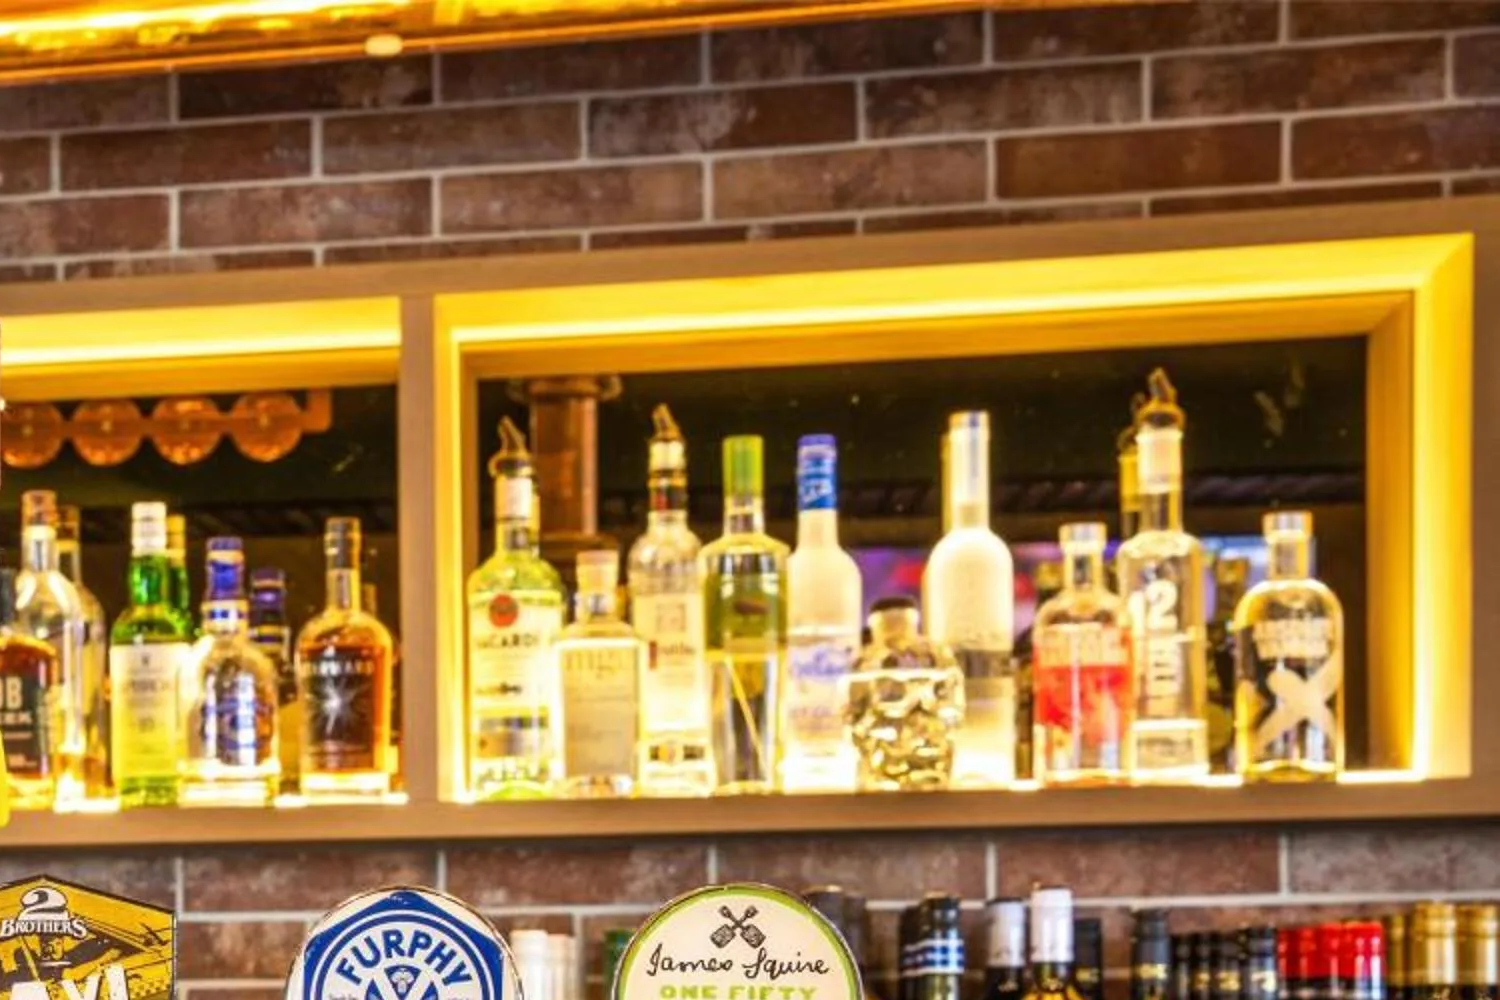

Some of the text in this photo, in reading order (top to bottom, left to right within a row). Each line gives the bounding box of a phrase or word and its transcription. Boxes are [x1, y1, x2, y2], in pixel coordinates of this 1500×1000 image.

[17, 886, 70, 921] 2
[0, 918, 88, 939] BROTHERS
[335, 928, 473, 987] FURPHY
[646, 943, 830, 981] James Squire
[660, 985, 817, 1000] ONE FIFTY
